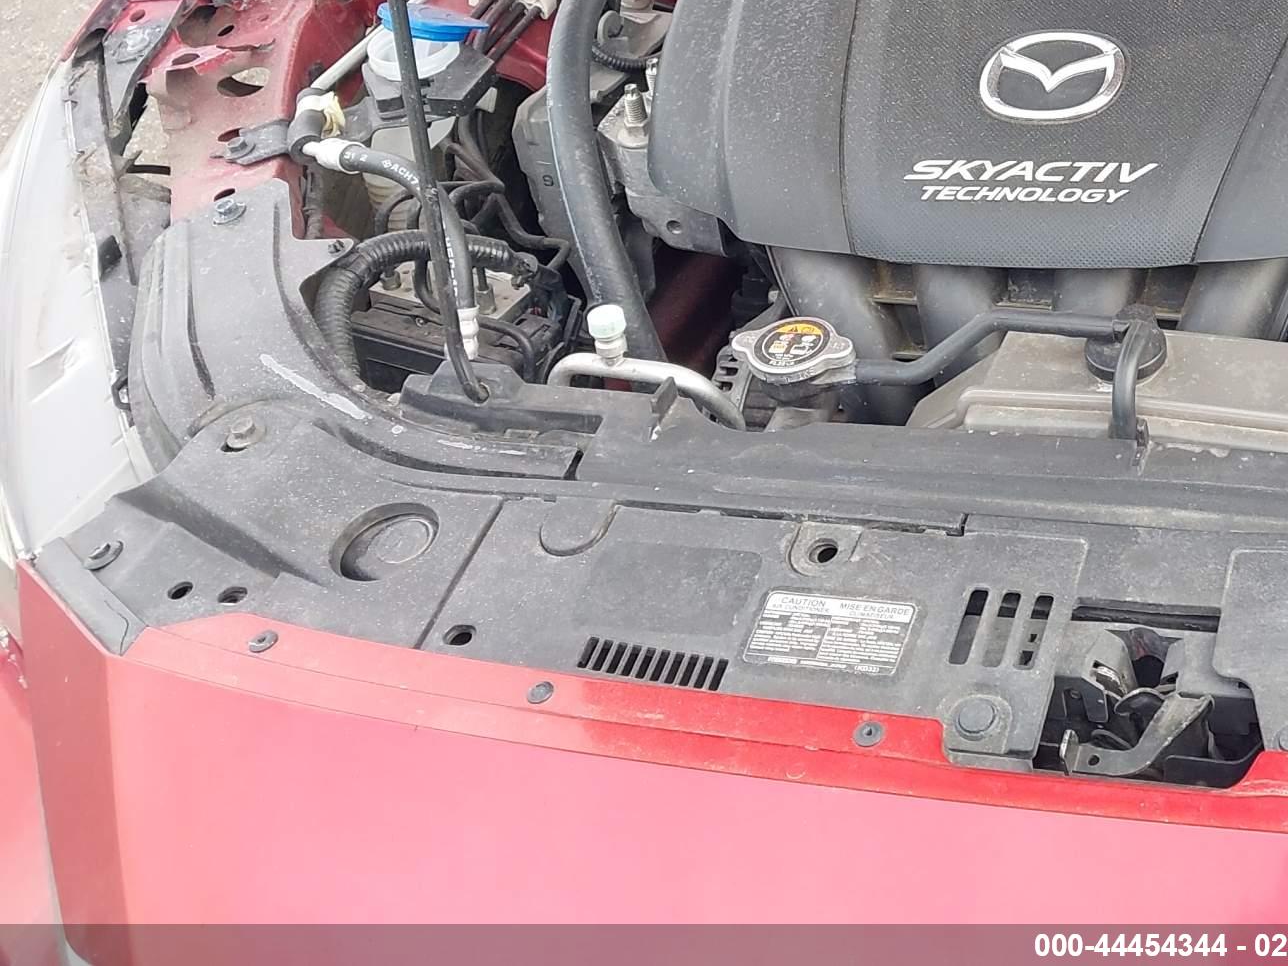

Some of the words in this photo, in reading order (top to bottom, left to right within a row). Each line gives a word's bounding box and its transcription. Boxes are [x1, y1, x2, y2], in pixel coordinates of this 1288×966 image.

[904, 159, 1159, 183] SKYACTIV
[920, 185, 1130, 203] TECHNOLOGY
[781, 596, 826, 607] CAUTION
[839, 602, 860, 611] MISE
[875, 605, 910, 616] GARDE
